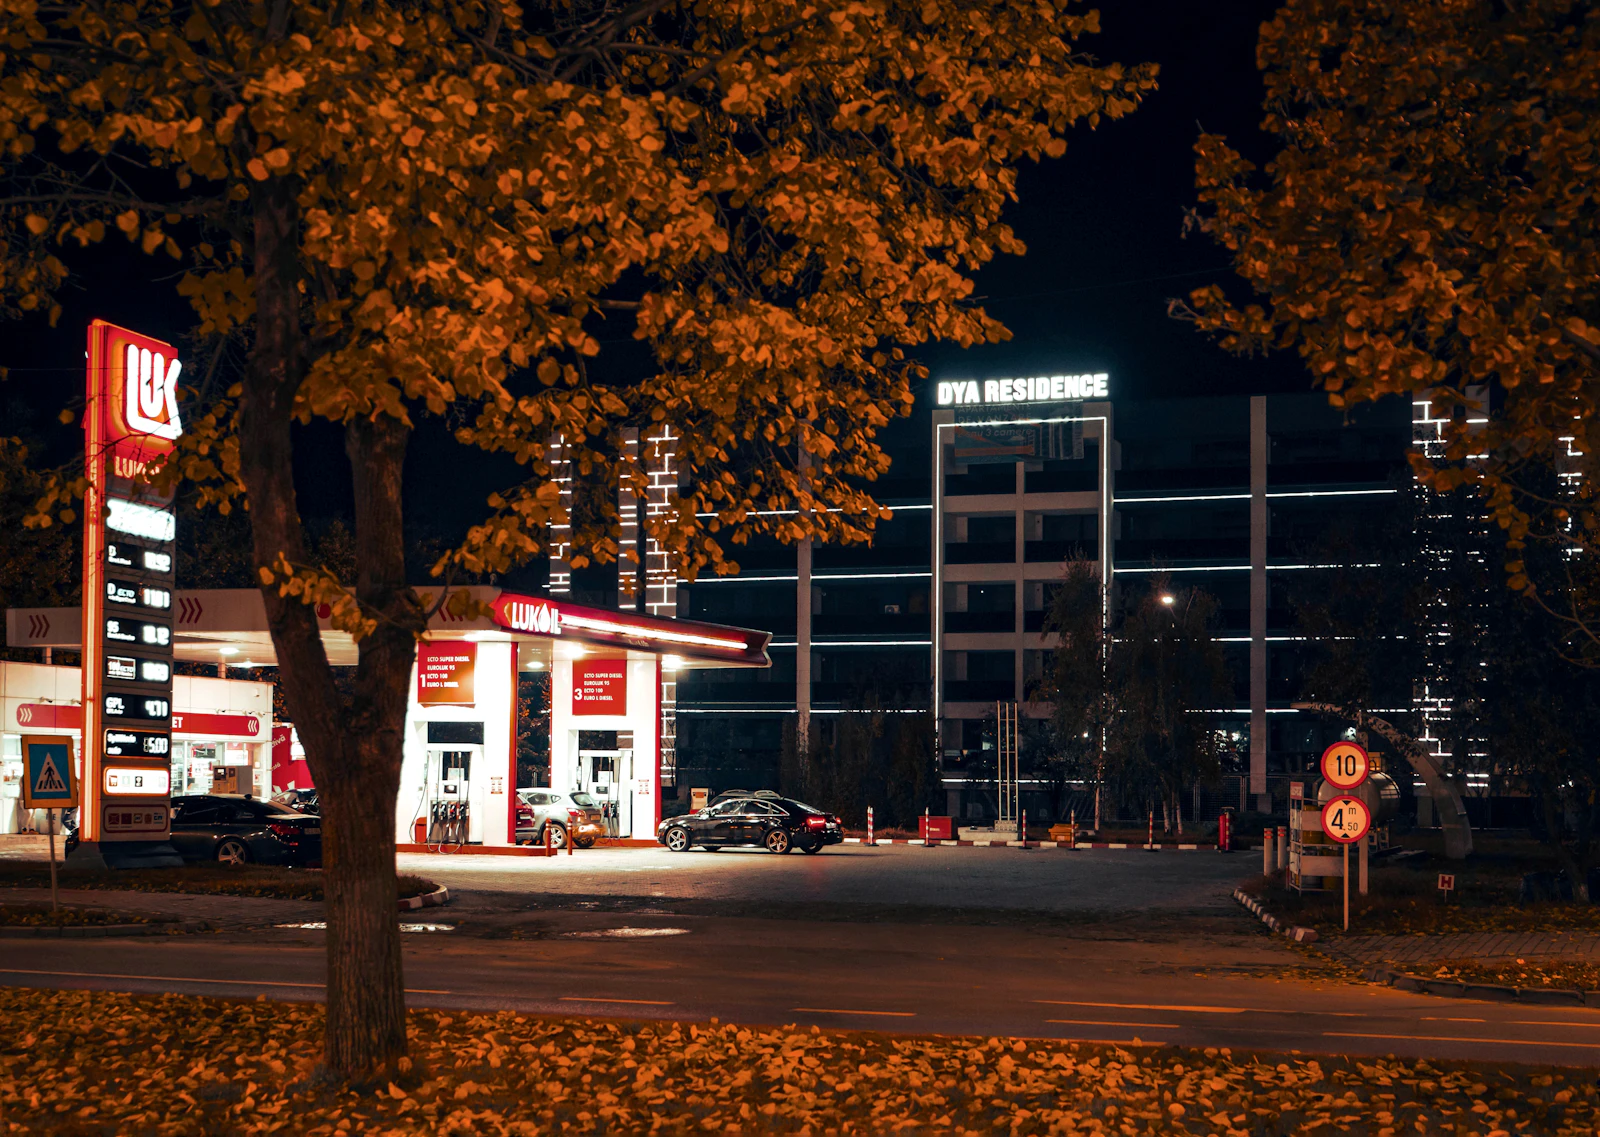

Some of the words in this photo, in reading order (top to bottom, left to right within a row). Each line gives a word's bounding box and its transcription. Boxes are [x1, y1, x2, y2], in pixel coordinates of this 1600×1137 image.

[937, 382, 980, 405] DYA
[984, 373, 1109, 402] RESIDENCE
[985, 428, 992, 437] 3
[107, 583, 116, 595] D
[511, 602, 561, 635] LUKOIL
[420, 674, 426, 688] 1
[574, 688, 583, 701] 3
[106, 697, 125, 710] GPL
[1336, 755, 1356, 776] 10
[1348, 807, 1356, 815] m
[1441, 875, 1452, 889] H
